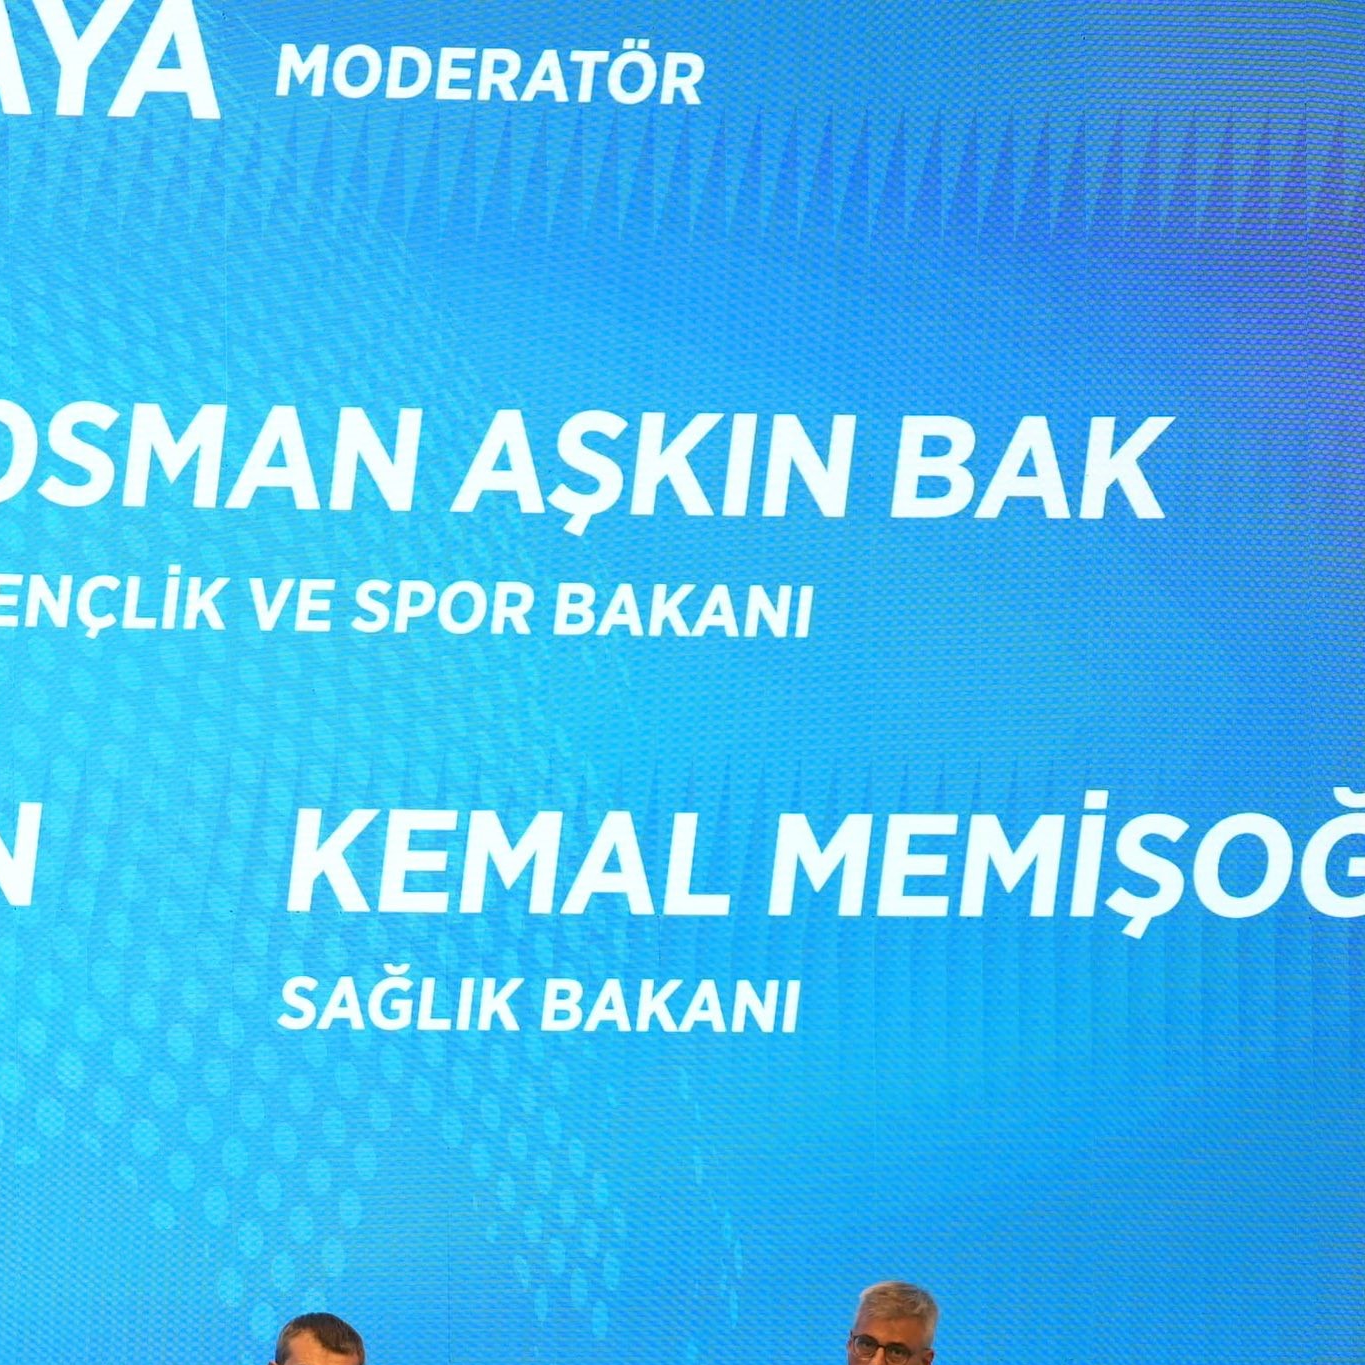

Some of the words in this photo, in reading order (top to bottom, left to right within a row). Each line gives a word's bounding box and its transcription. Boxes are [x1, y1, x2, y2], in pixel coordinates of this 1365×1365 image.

[275, 38, 705, 105] MODERATÖR
[450, 409, 856, 536] AŞKIN
[891, 415, 1175, 519] BAK
[250, 578, 335, 632] VE
[352, 579, 535, 635] SPOR
[554, 582, 813, 638] BAKANI
[287, 808, 730, 916] KEMAL
[768, 787, 1365, 939] MEMİŞOĞ
[278, 963, 523, 1031] SAĞLIK
[541, 979, 800, 1033] BAKANI
